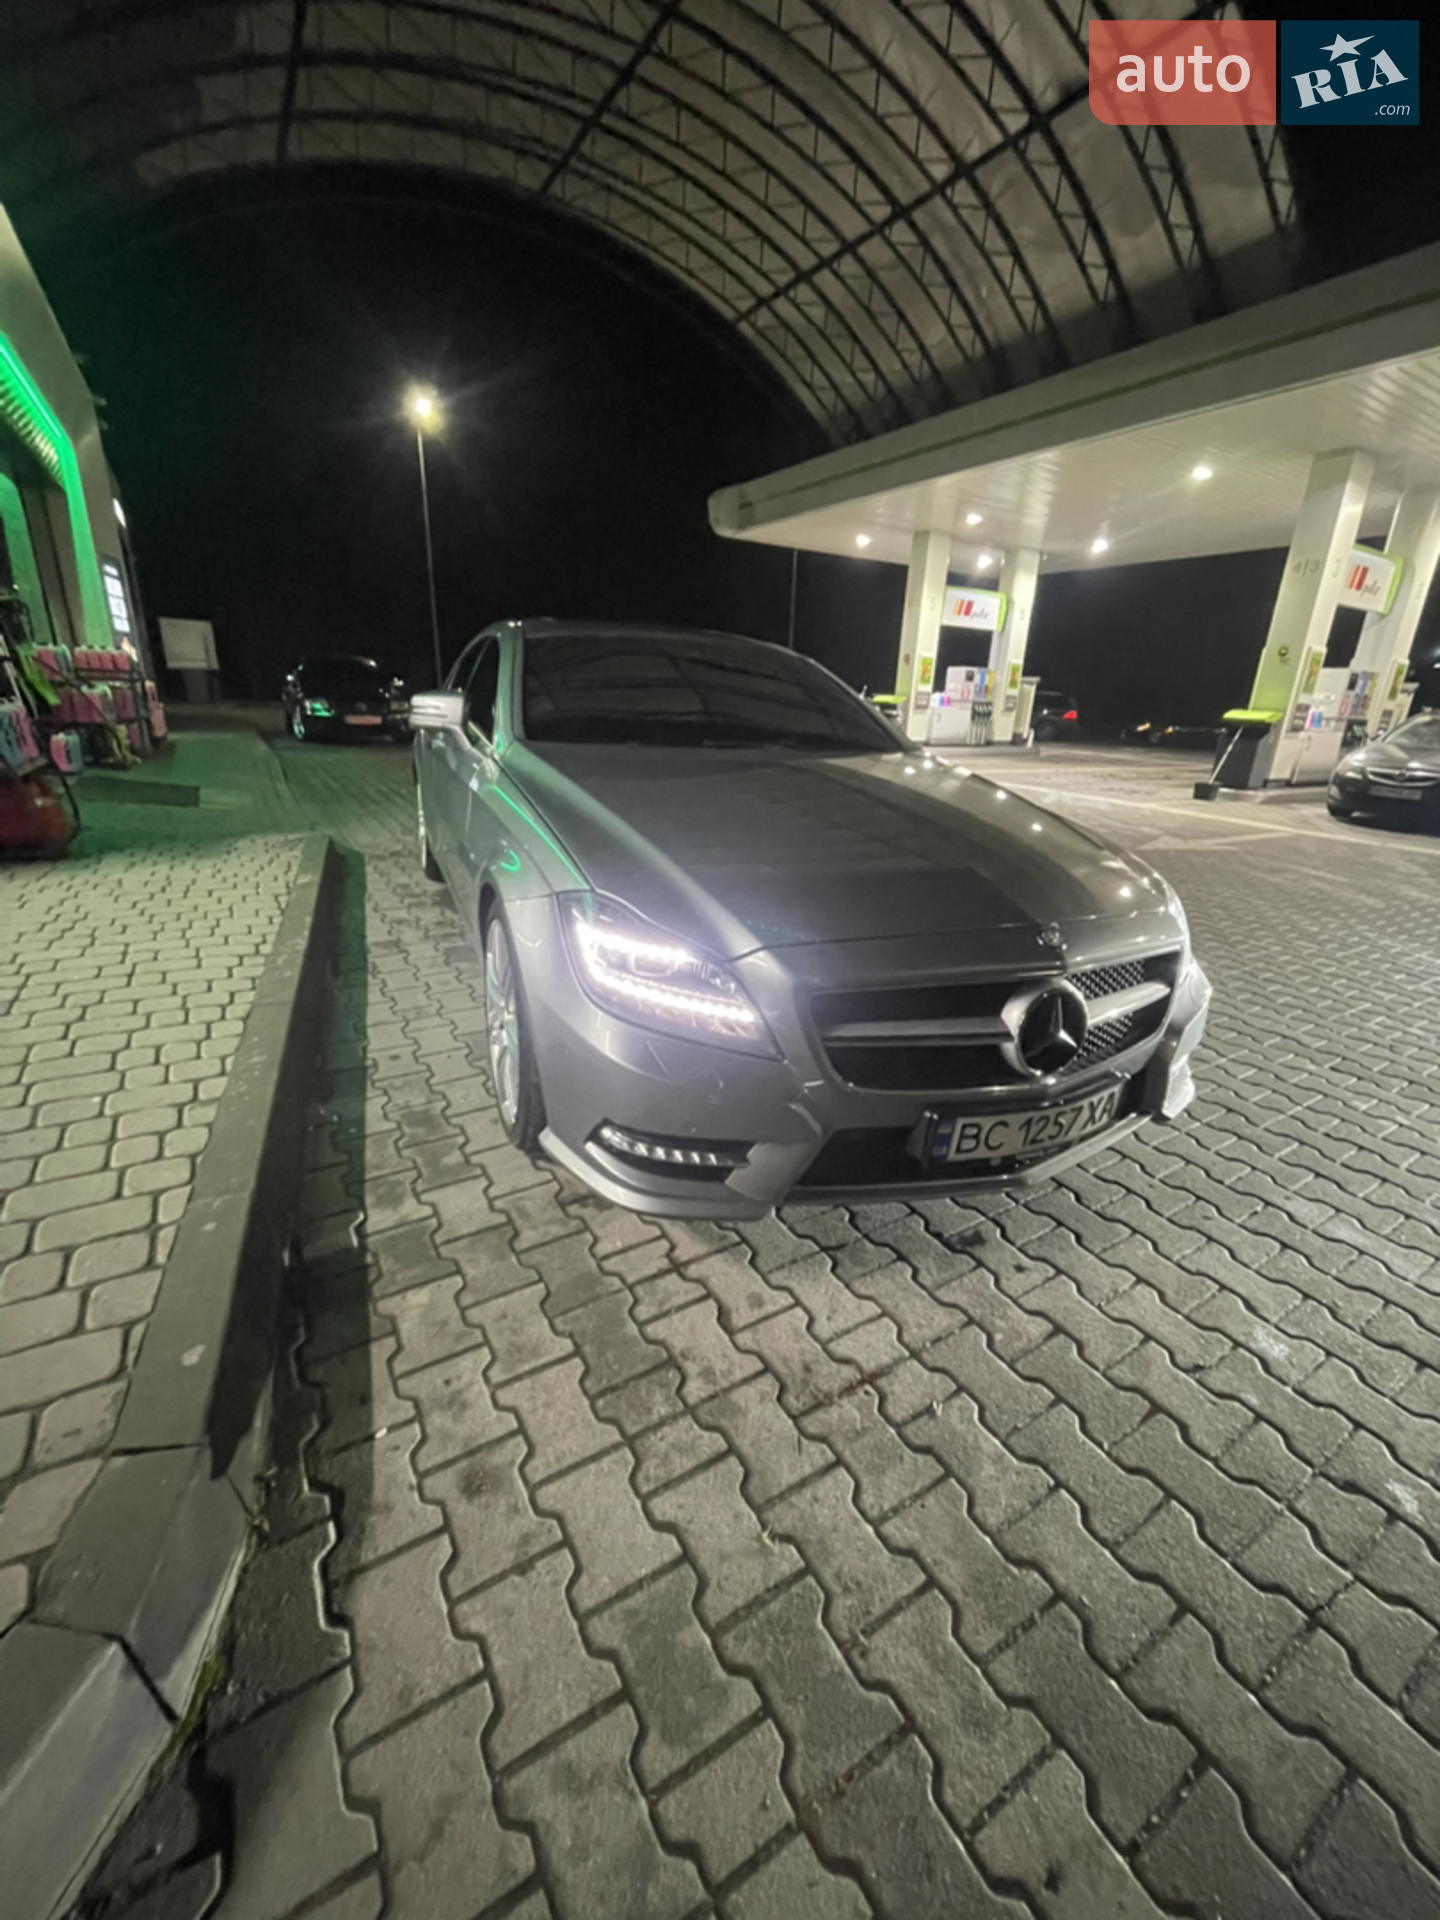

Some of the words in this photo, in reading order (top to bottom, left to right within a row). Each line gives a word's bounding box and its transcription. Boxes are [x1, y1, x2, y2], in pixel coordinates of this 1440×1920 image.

[955, 1121, 1009, 1154] BC
[1018, 1106, 1084, 1147] 1257
[1081, 1091, 1116, 1131] XA
